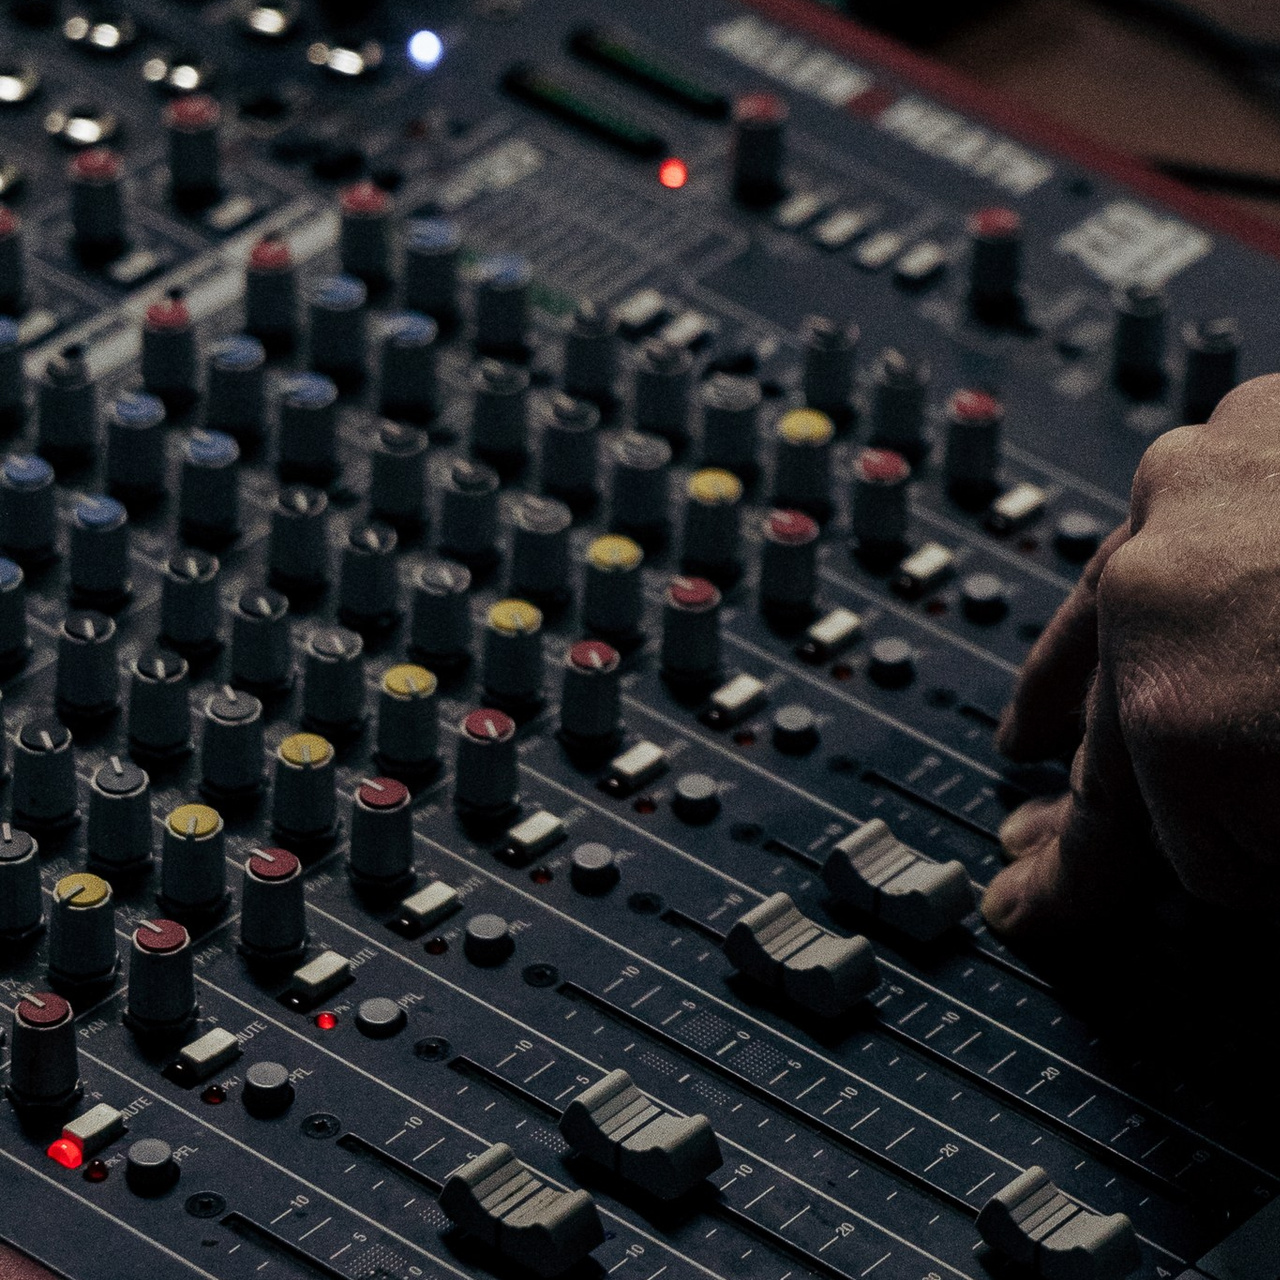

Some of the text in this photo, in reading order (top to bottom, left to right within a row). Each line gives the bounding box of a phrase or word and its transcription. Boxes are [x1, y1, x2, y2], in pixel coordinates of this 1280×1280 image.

[620, 965, 640, 979] 10
[682, 999, 697, 1010] 5
[79, 1018, 109, 1039] PAN
[514, 1040, 534, 1055] 10
[787, 1058, 802, 1070] 5
[289, 1067, 314, 1085] PFL
[576, 1074, 590, 1086] 5
[1041, 1066, 1061, 1081] 20
[840, 1086, 859, 1101] 10
[403, 1116, 423, 1130] 10
[173, 1144, 199, 1164] PFL
[939, 1142, 960, 1158] 20
[734, 1164, 754, 1178] 10
[290, 1194, 310, 1209] 10
[352, 1231, 367, 1243] 5
[835, 1222, 855, 1238] 20
[625, 1244, 646, 1258] 10
[408, 1265, 423, 1277] 0
[1156, 1265, 1172, 1279] 4
